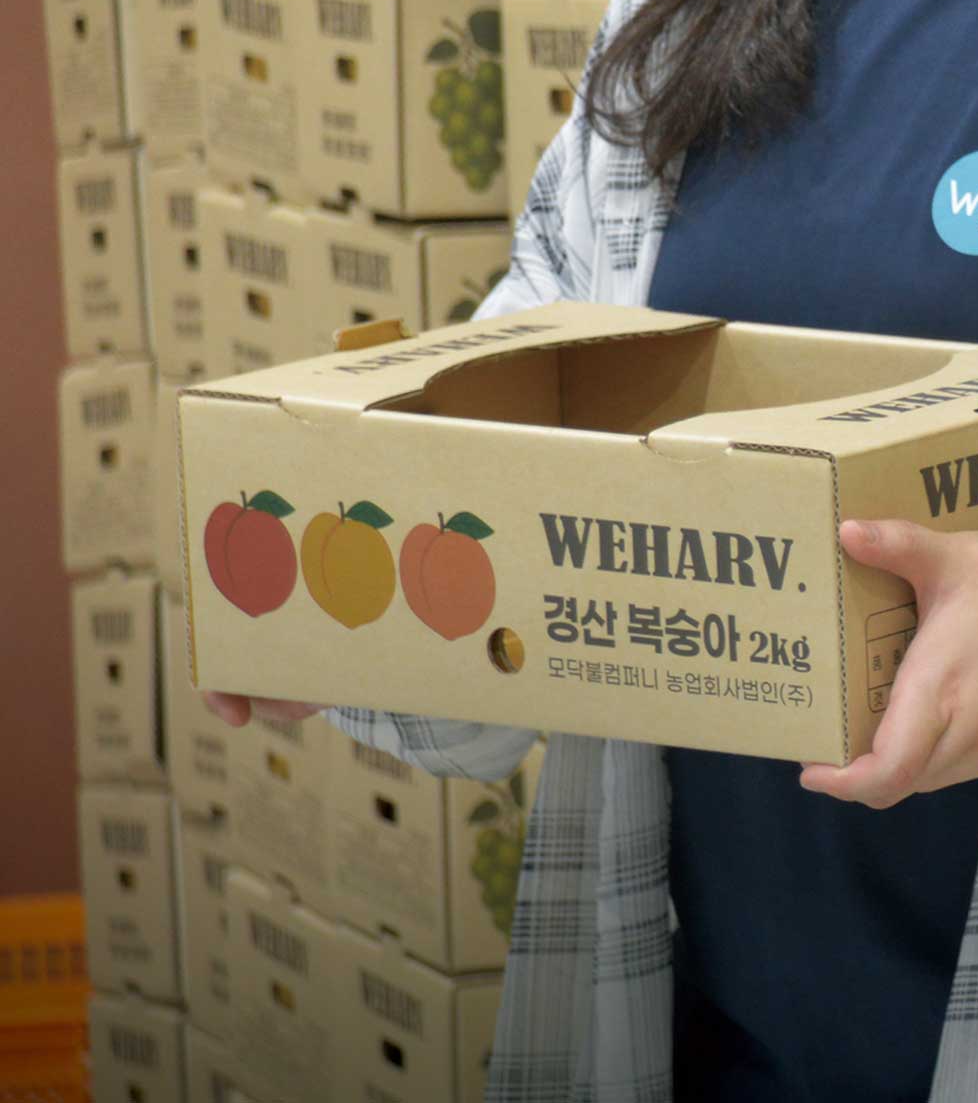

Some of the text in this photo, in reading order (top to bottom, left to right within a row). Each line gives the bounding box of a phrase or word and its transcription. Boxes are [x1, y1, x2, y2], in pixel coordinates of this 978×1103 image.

[539, 512, 807, 593] WEHARV.
[543, 594, 812, 673] 경산 복숭아 2kg
[548, 656, 814, 709] 모닥불컴퍼니 농업회사법인(주)
